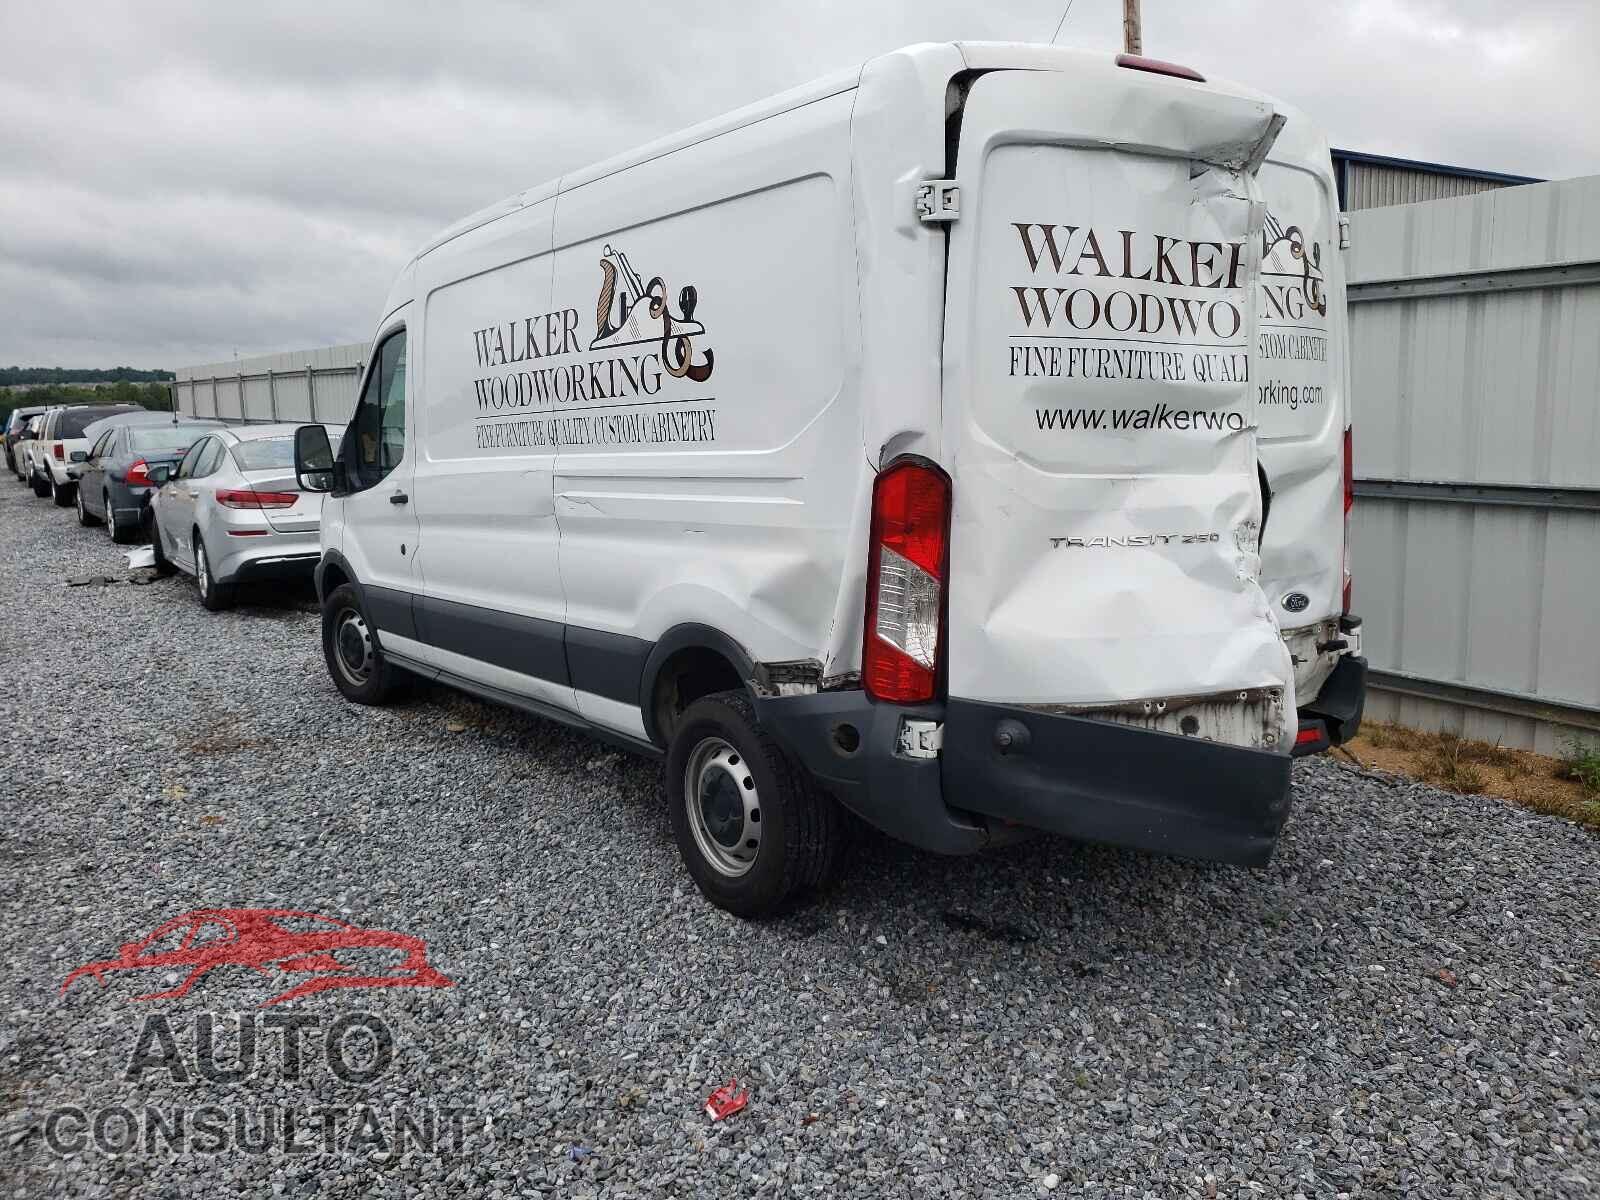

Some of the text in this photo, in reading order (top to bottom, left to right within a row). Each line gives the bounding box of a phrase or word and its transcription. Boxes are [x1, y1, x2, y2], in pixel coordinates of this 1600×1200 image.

[1008, 285, 1247, 339] WOODWO
[473, 307, 583, 369] WALKER
[473, 353, 663, 411] WOODWORKING
[1008, 346, 1062, 377] FINE
[1067, 347, 1185, 382] FURNITURE
[594, 413, 641, 445] CUSTOM
[642, 409, 716, 444] CABINETRY
[1049, 531, 1220, 549] TRANSIT 250
